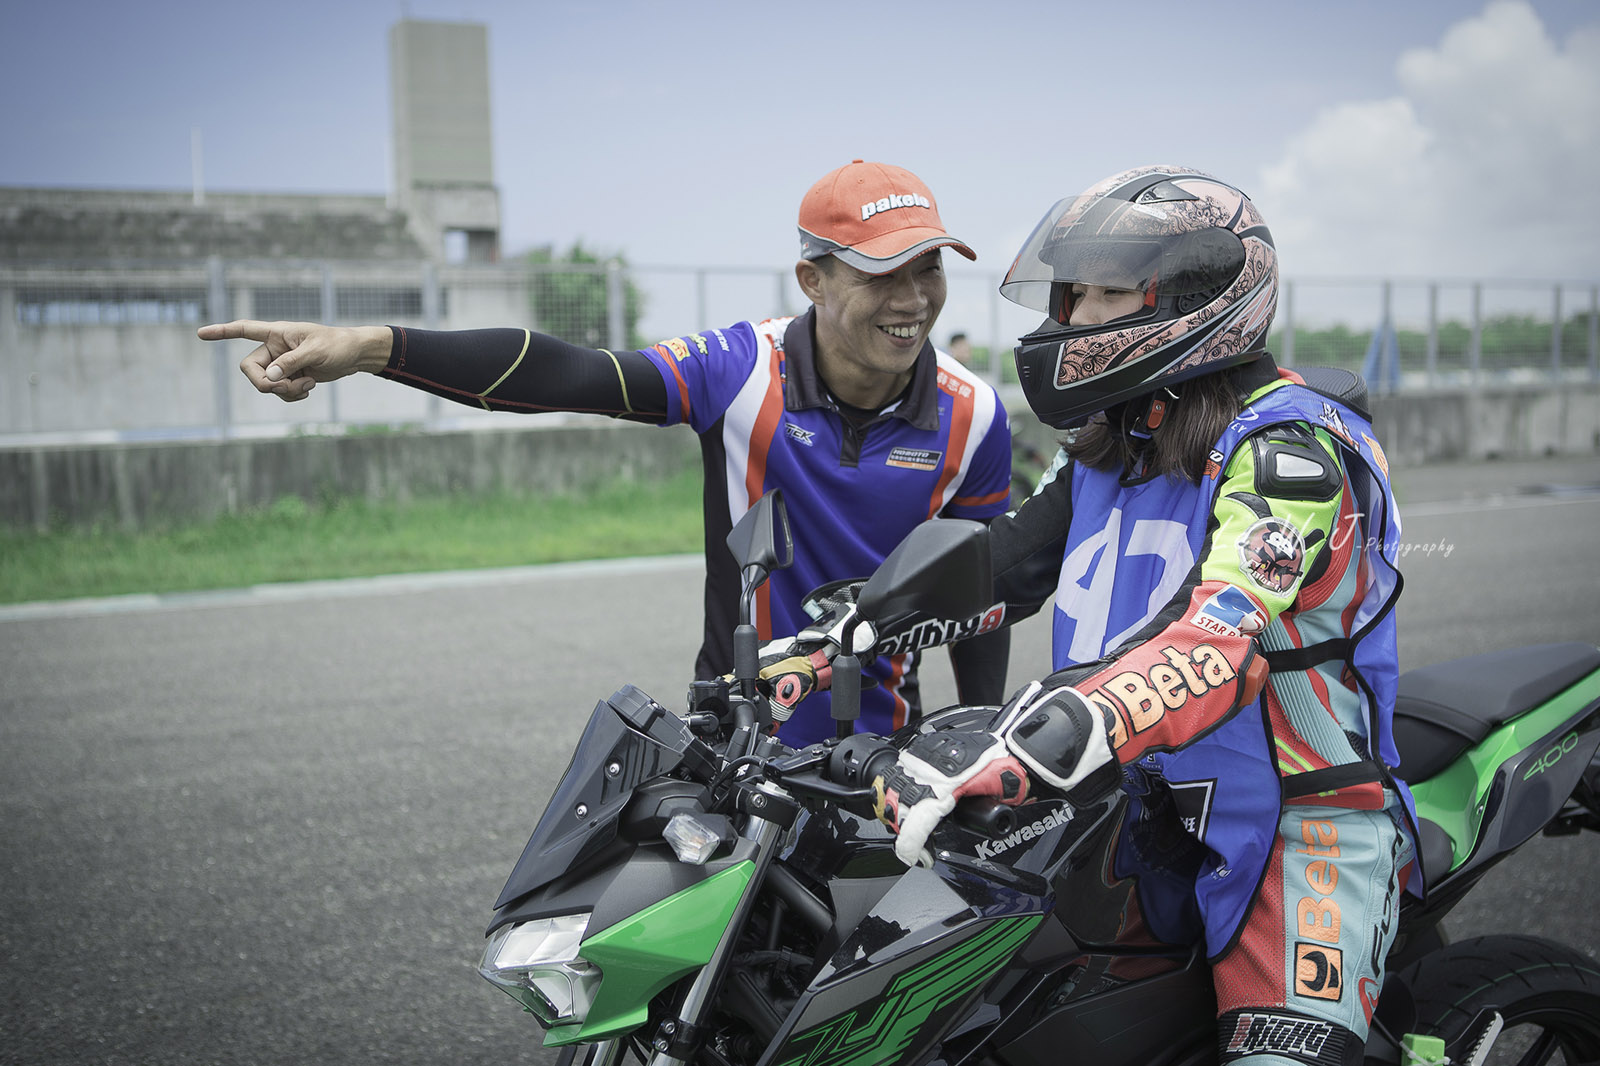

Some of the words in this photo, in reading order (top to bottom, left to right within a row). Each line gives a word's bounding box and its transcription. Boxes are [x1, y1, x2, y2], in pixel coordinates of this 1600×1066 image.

[1197, 616, 1228, 635] STAR
[1101, 643, 1239, 736] Beta
[1523, 731, 1579, 781] 400
[974, 803, 1075, 860] Kawasaki
[1296, 819, 1342, 944] Beta
